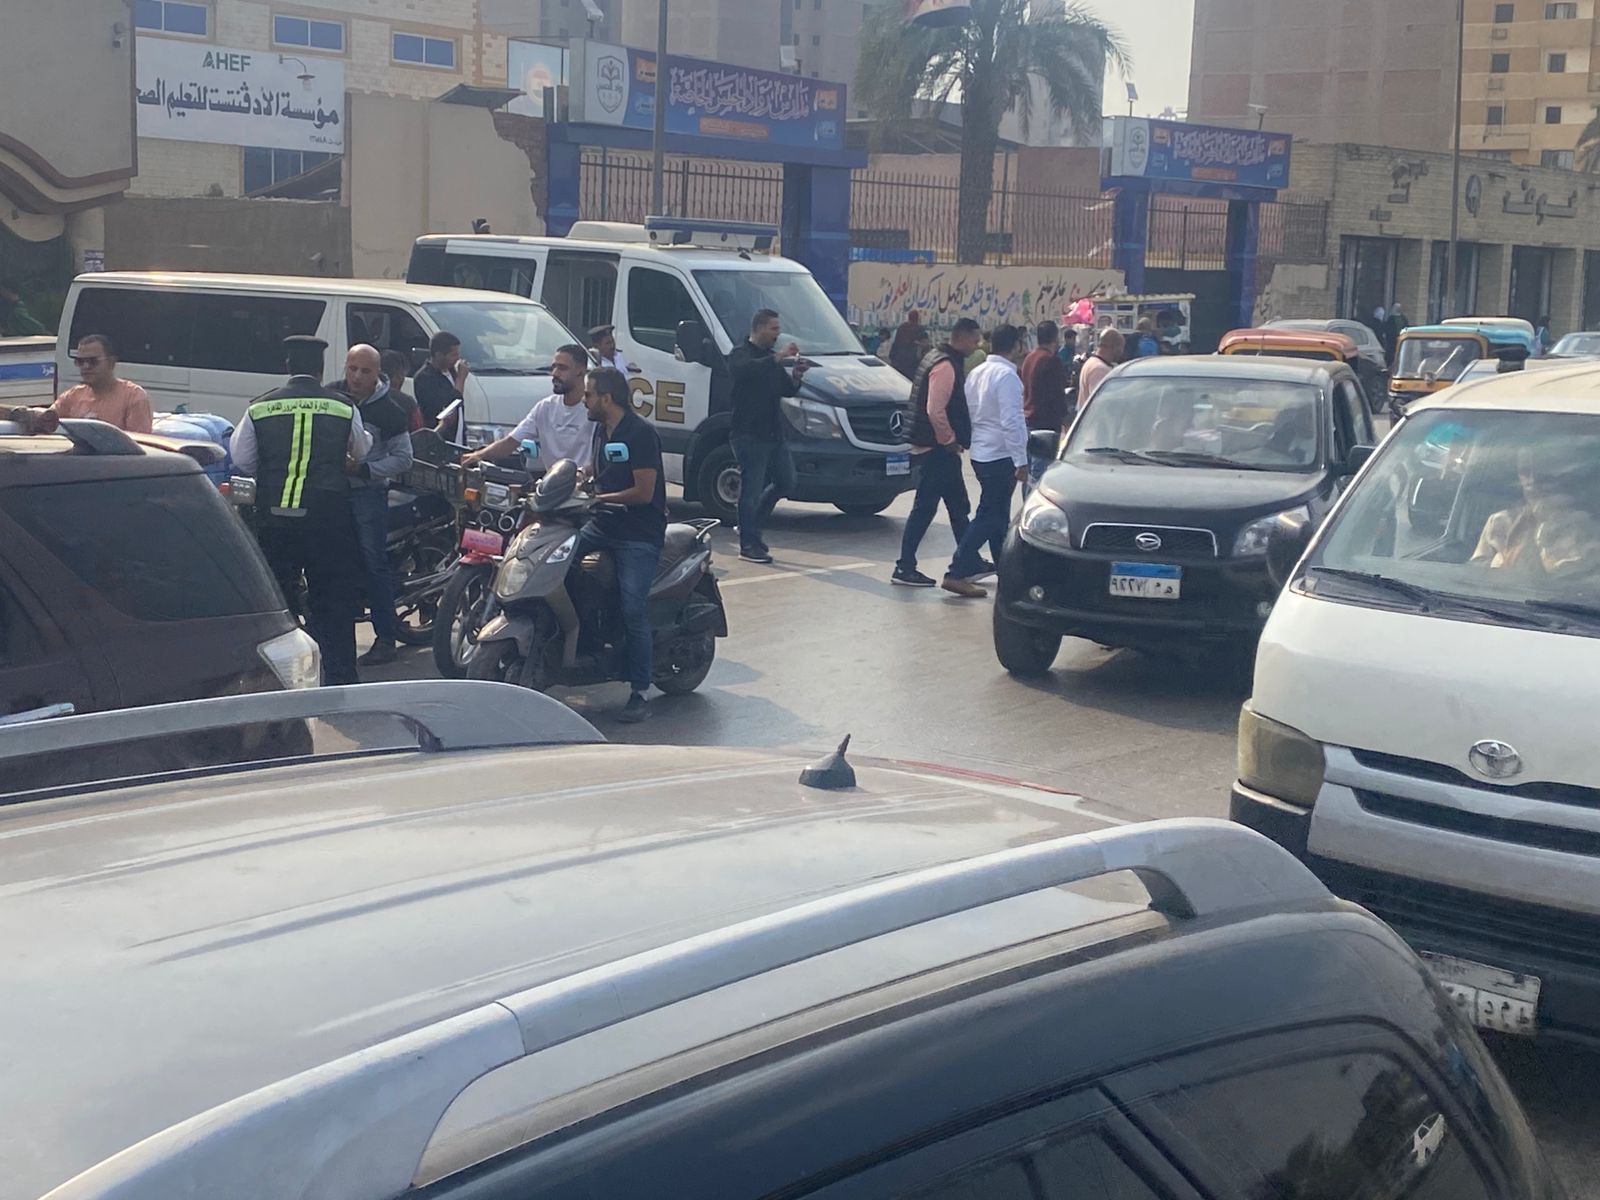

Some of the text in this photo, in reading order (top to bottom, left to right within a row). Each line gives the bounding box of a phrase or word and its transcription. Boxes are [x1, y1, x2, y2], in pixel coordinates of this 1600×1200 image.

[202, 51, 251, 72] AHEF
[167, 82, 208, 119] للتعليم
[281, 92, 340, 129] مؤسسة
